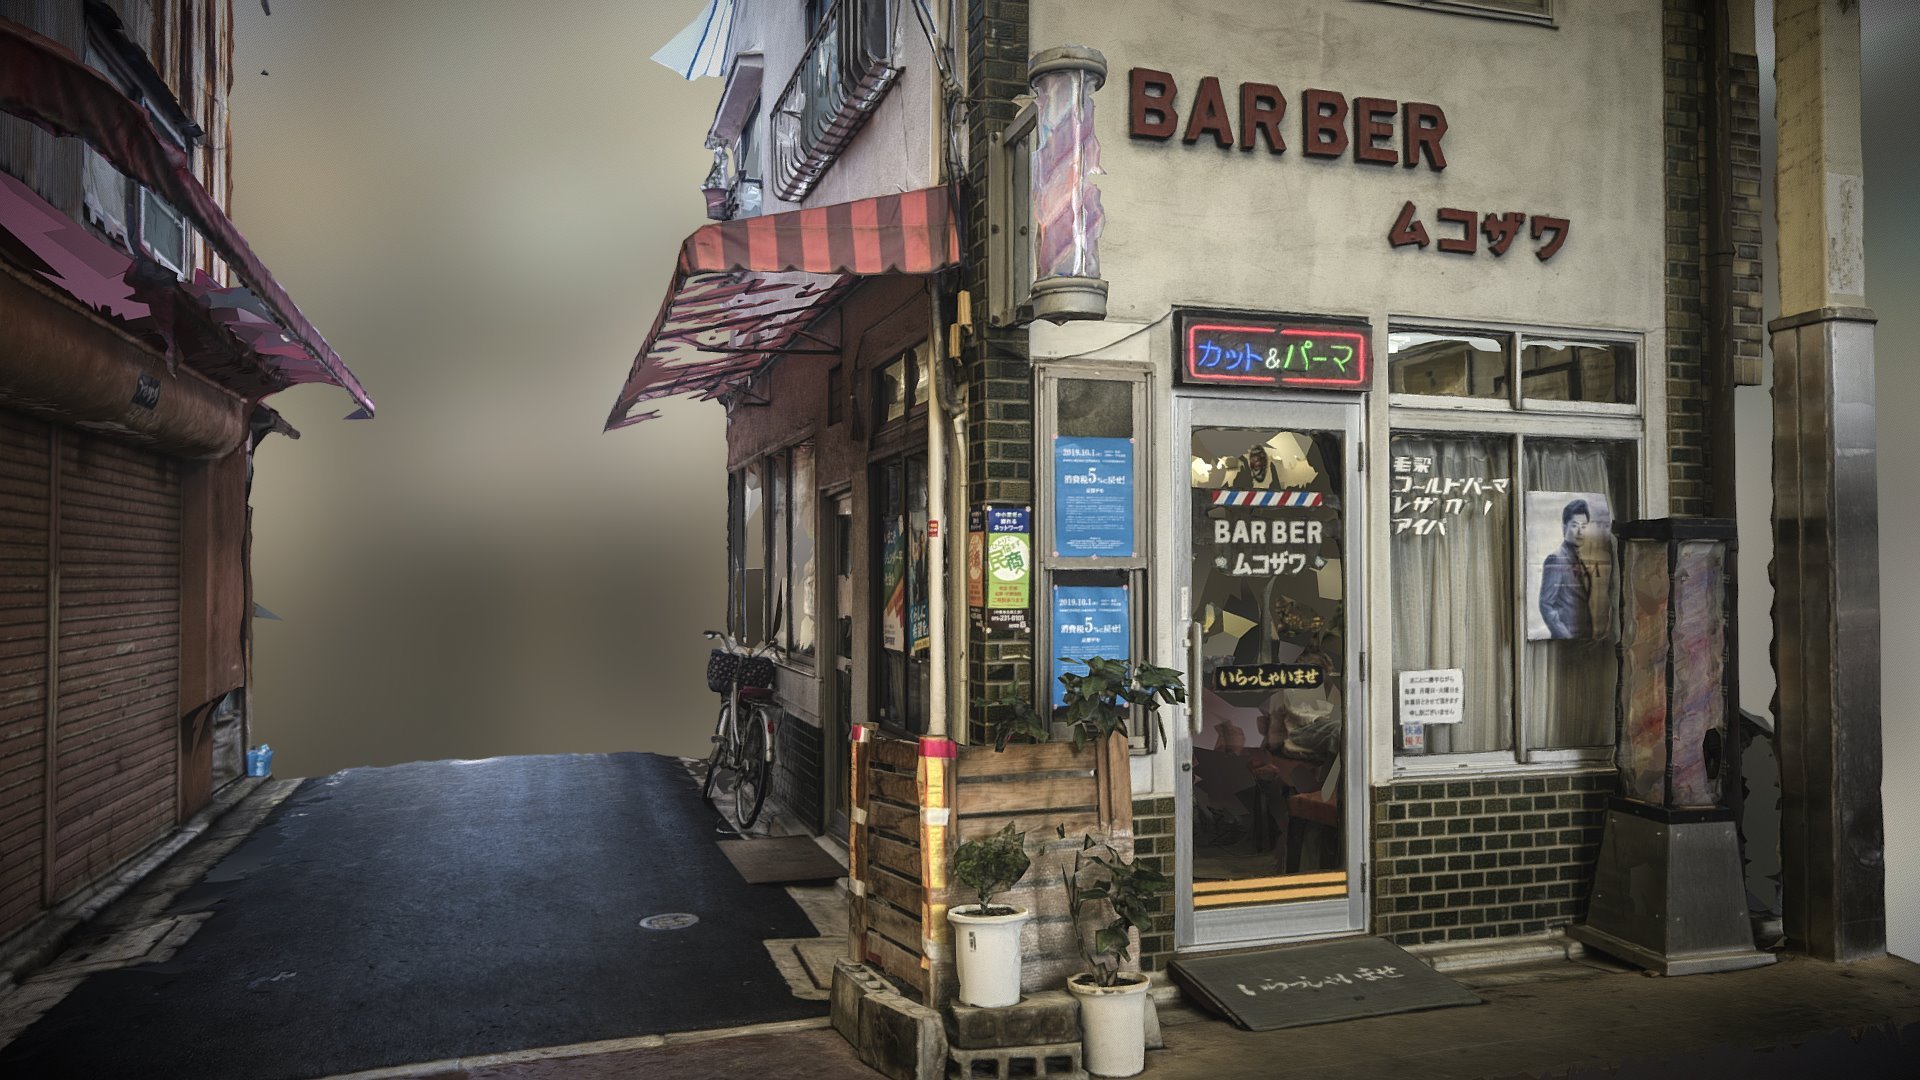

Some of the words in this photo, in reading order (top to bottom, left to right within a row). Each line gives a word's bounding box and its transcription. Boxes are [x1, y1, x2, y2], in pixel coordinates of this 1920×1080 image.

[1129, 66, 1448, 172] BARBER
[1388, 200, 1571, 262] ムコザワ
[1198, 339, 1354, 373] カット&パーマ
[1391, 477, 1511, 496] コールドパーマ
[1214, 519, 1323, 544] BARBER
[1232, 550, 1306, 575] ムコザワ
[1219, 668, 1319, 687] いらっしゃいませ
